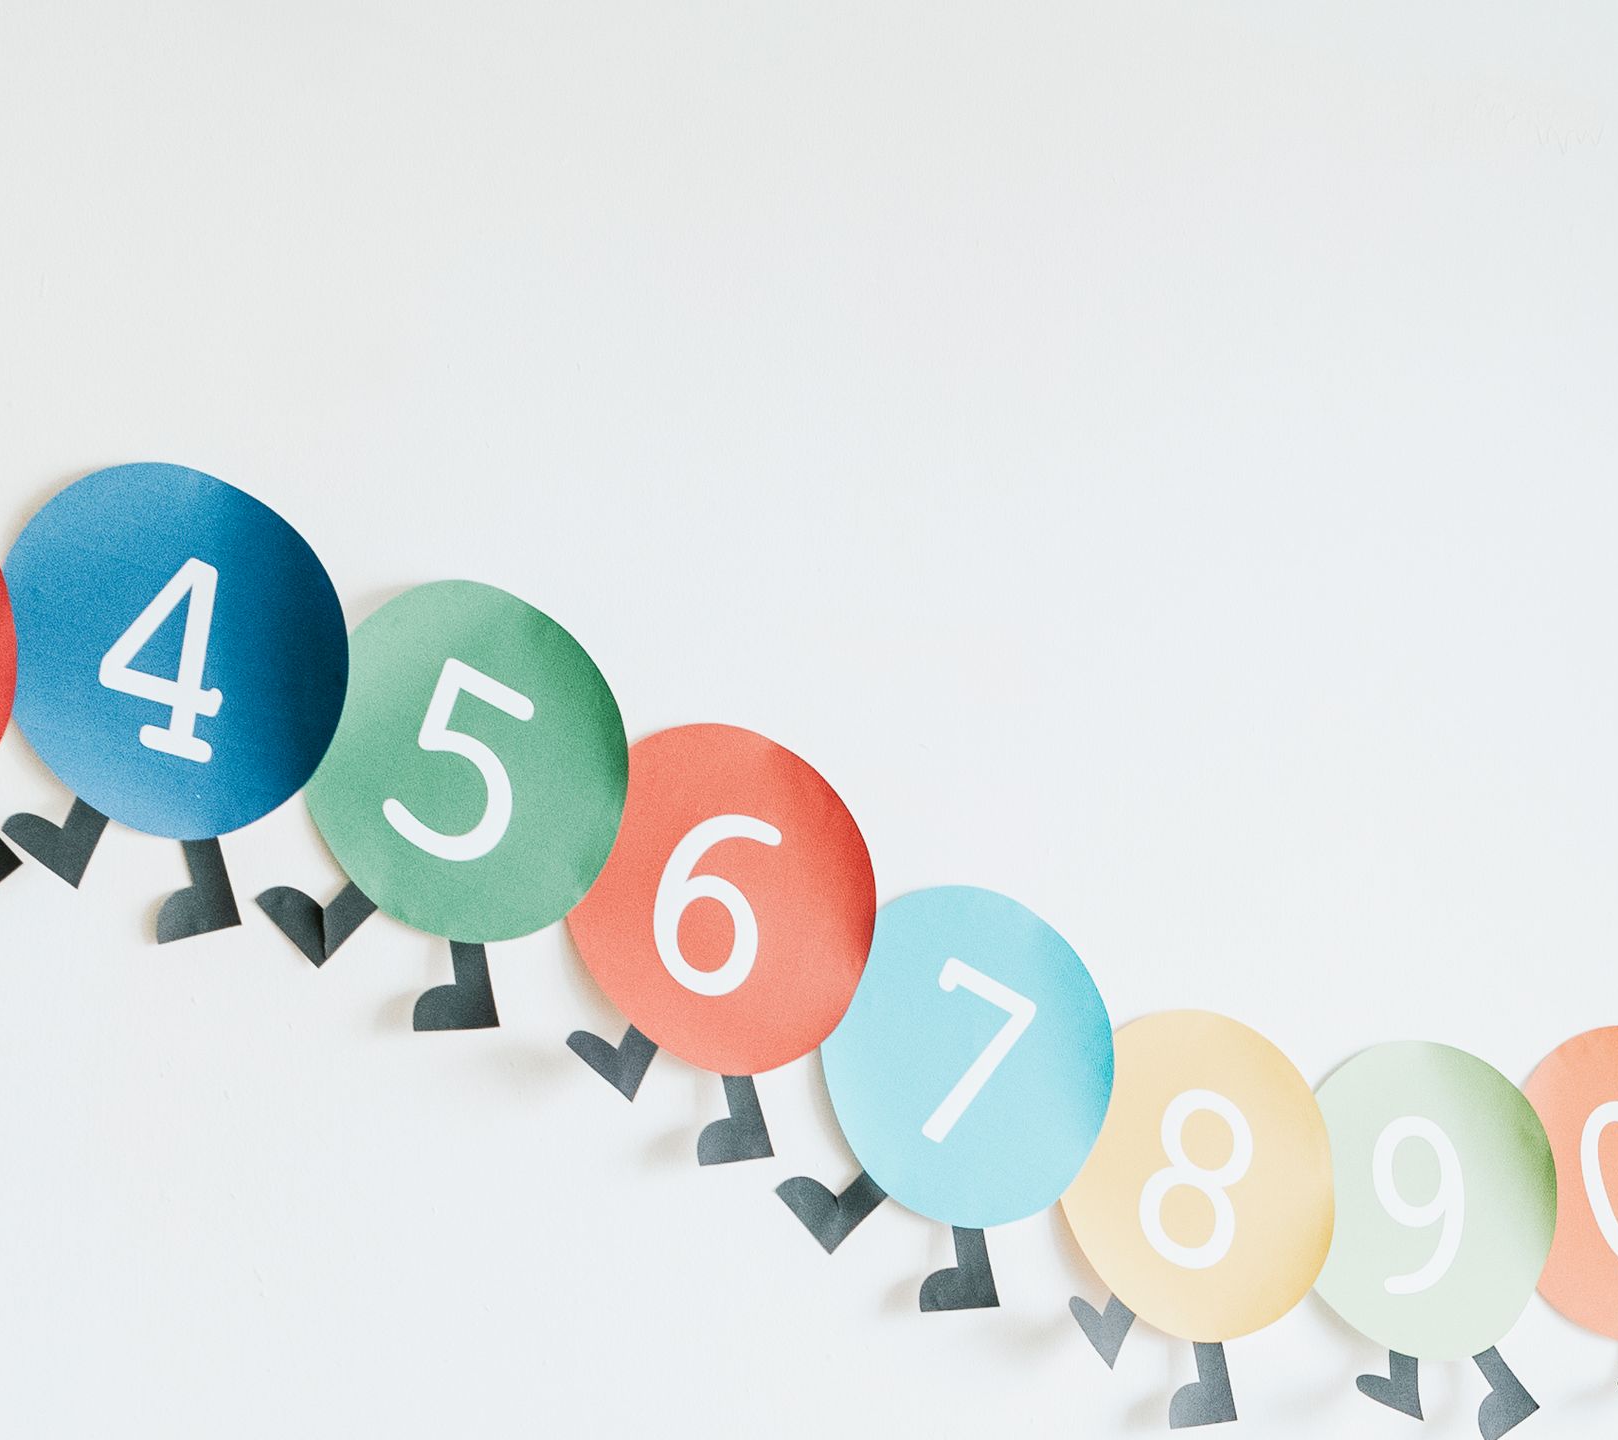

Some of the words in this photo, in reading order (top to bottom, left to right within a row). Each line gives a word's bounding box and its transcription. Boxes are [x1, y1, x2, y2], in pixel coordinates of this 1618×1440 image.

[98, 557, 223, 763] 4
[382, 656, 535, 862] 5
[652, 812, 782, 998] 6
[921, 956, 1037, 1144] 7
[1138, 1089, 1253, 1270] 8
[1371, 1115, 1466, 1295] 9
